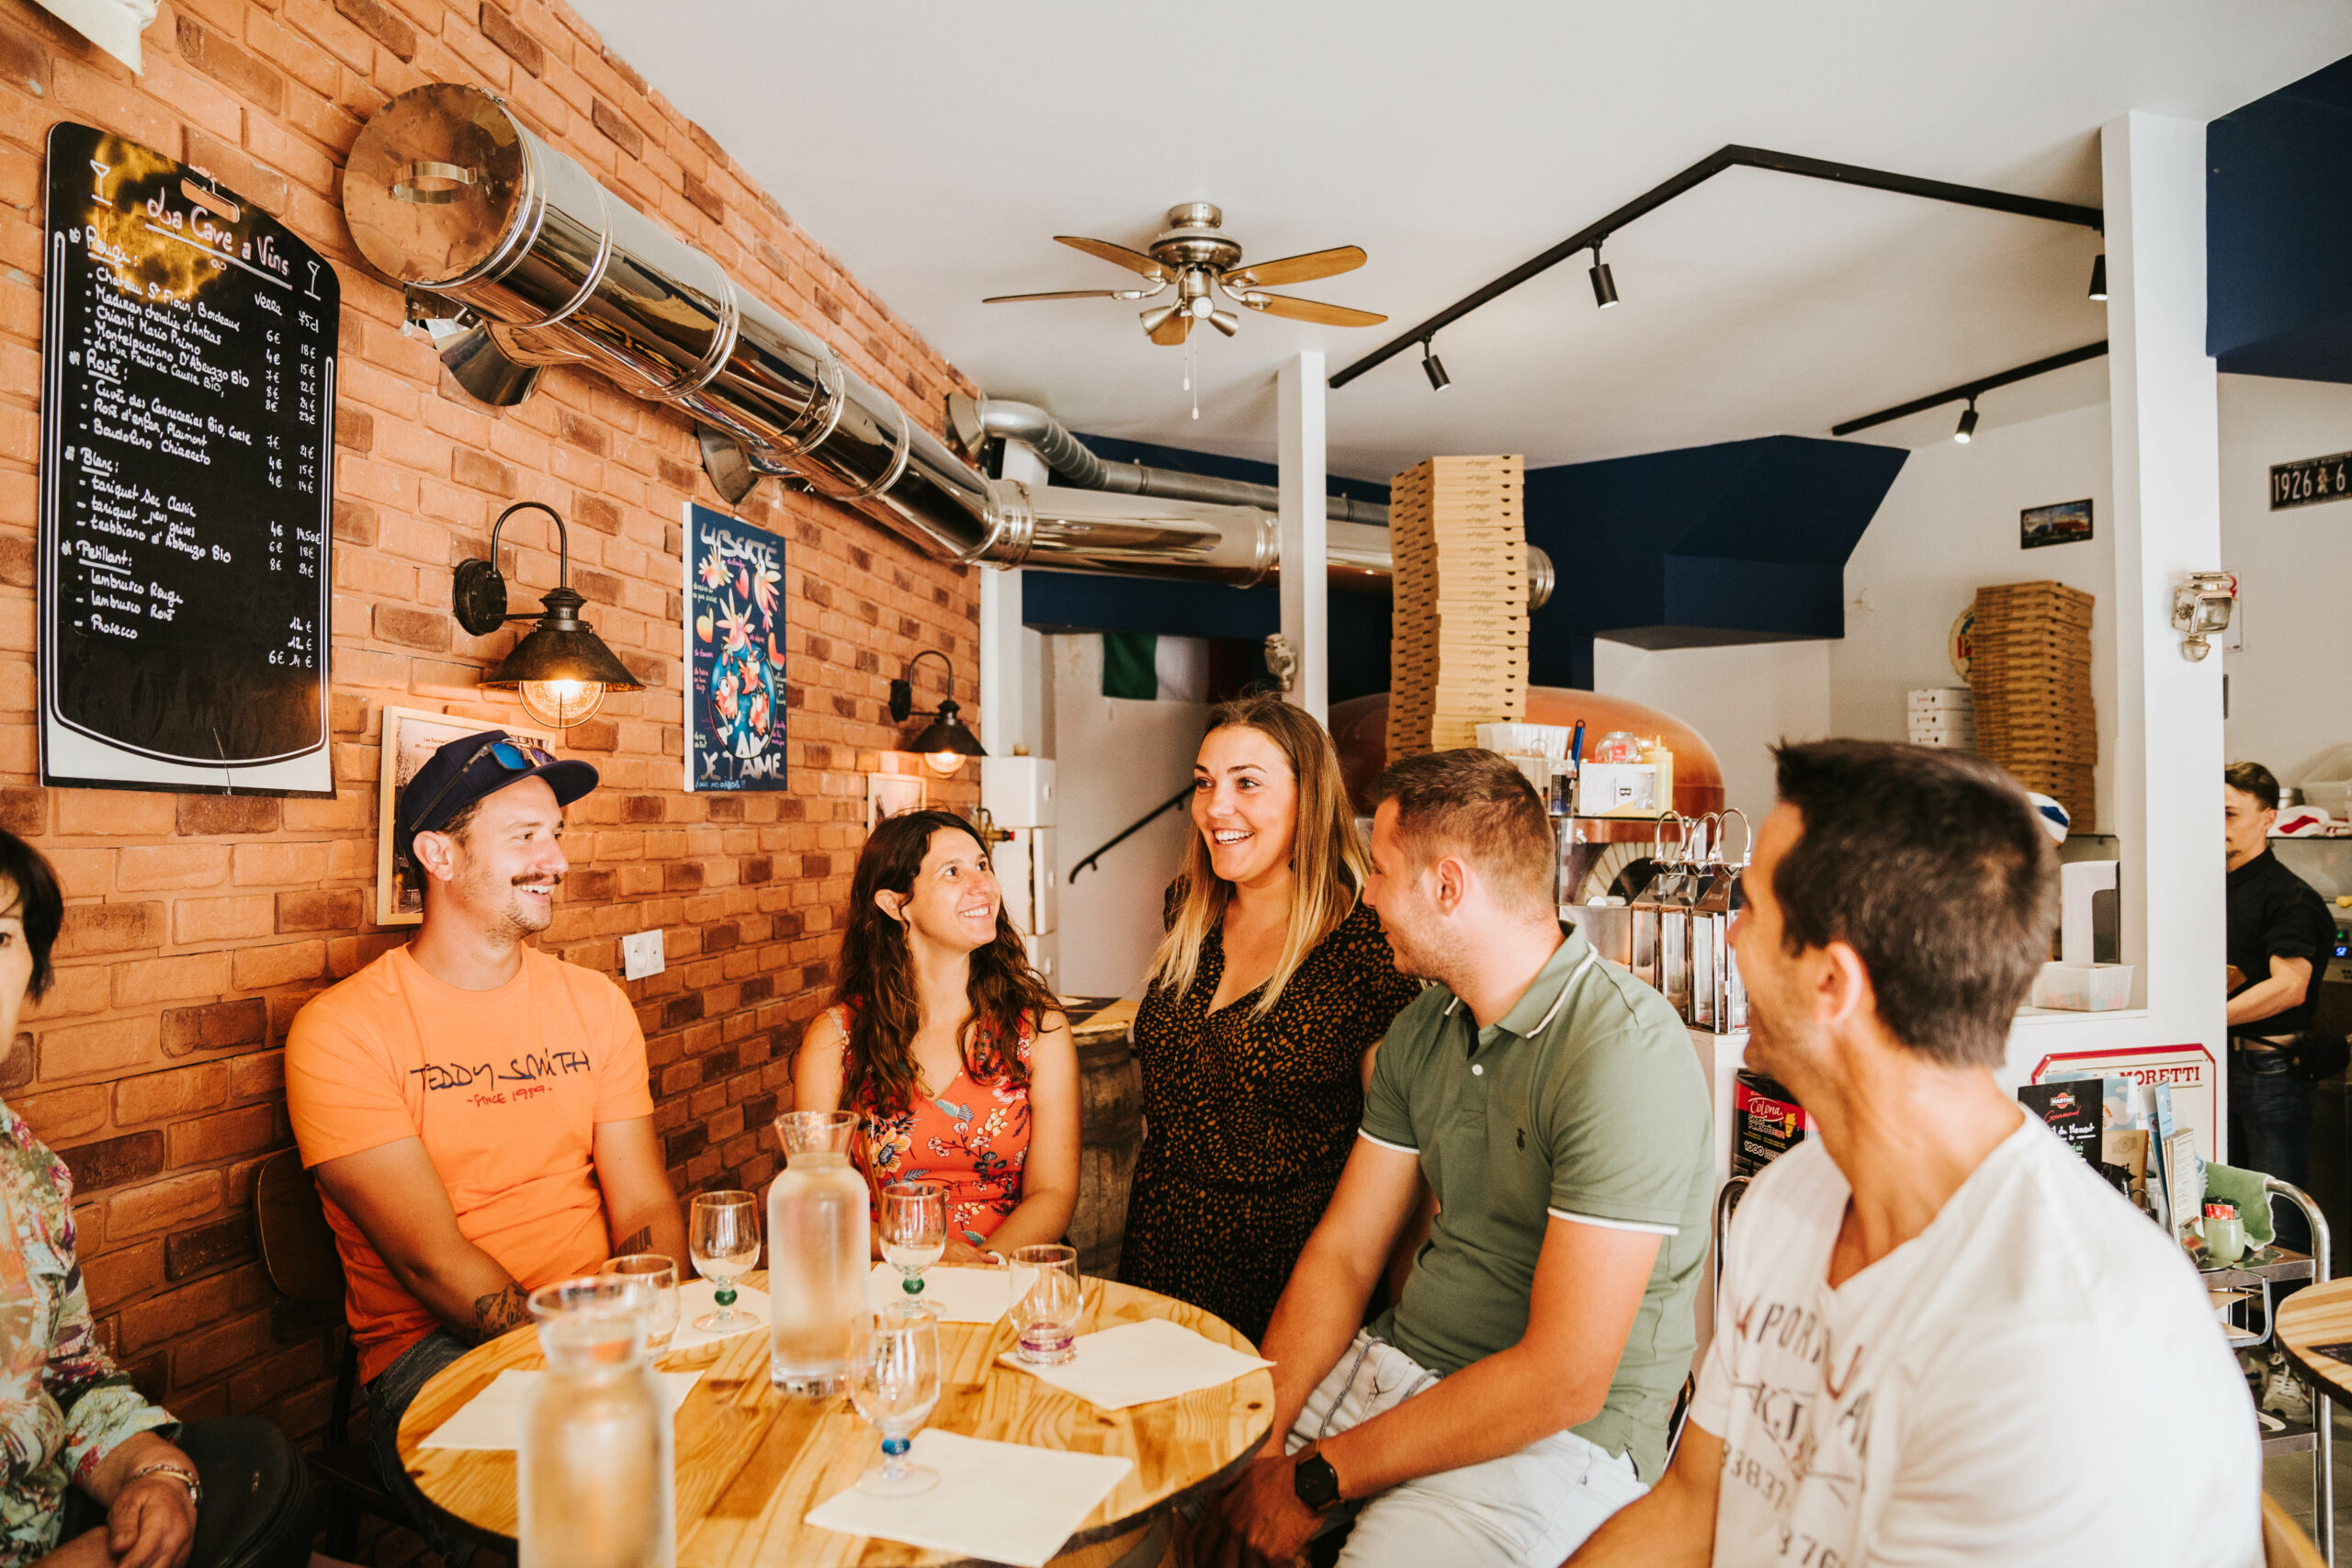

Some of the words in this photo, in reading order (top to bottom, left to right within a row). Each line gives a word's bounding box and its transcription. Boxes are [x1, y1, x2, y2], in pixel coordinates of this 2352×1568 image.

[147, 186, 183, 230] La
[190, 206, 232, 253] Cave
[257, 235, 290, 276] Vins
[171, 329, 201, 355] Primo
[266, 330, 281, 344] 6€
[300, 344, 316, 359] 18€
[266, 348, 281, 366] 4€
[300, 364, 316, 378] 15€
[266, 385, 280, 400] 8€
[265, 400, 278, 412] 8€
[266, 434, 280, 450] 7€
[268, 456, 283, 470] 4€
[299, 465, 315, 479] 15€
[267, 471, 283, 489] 4€
[2274, 469, 2312, 502] 1926
[268, 541, 284, 554] 6€
[300, 545, 315, 559] 18€
[269, 558, 282, 571] 8€
[268, 649, 285, 664] 6€
[410, 1063, 494, 1091] TEDDY
